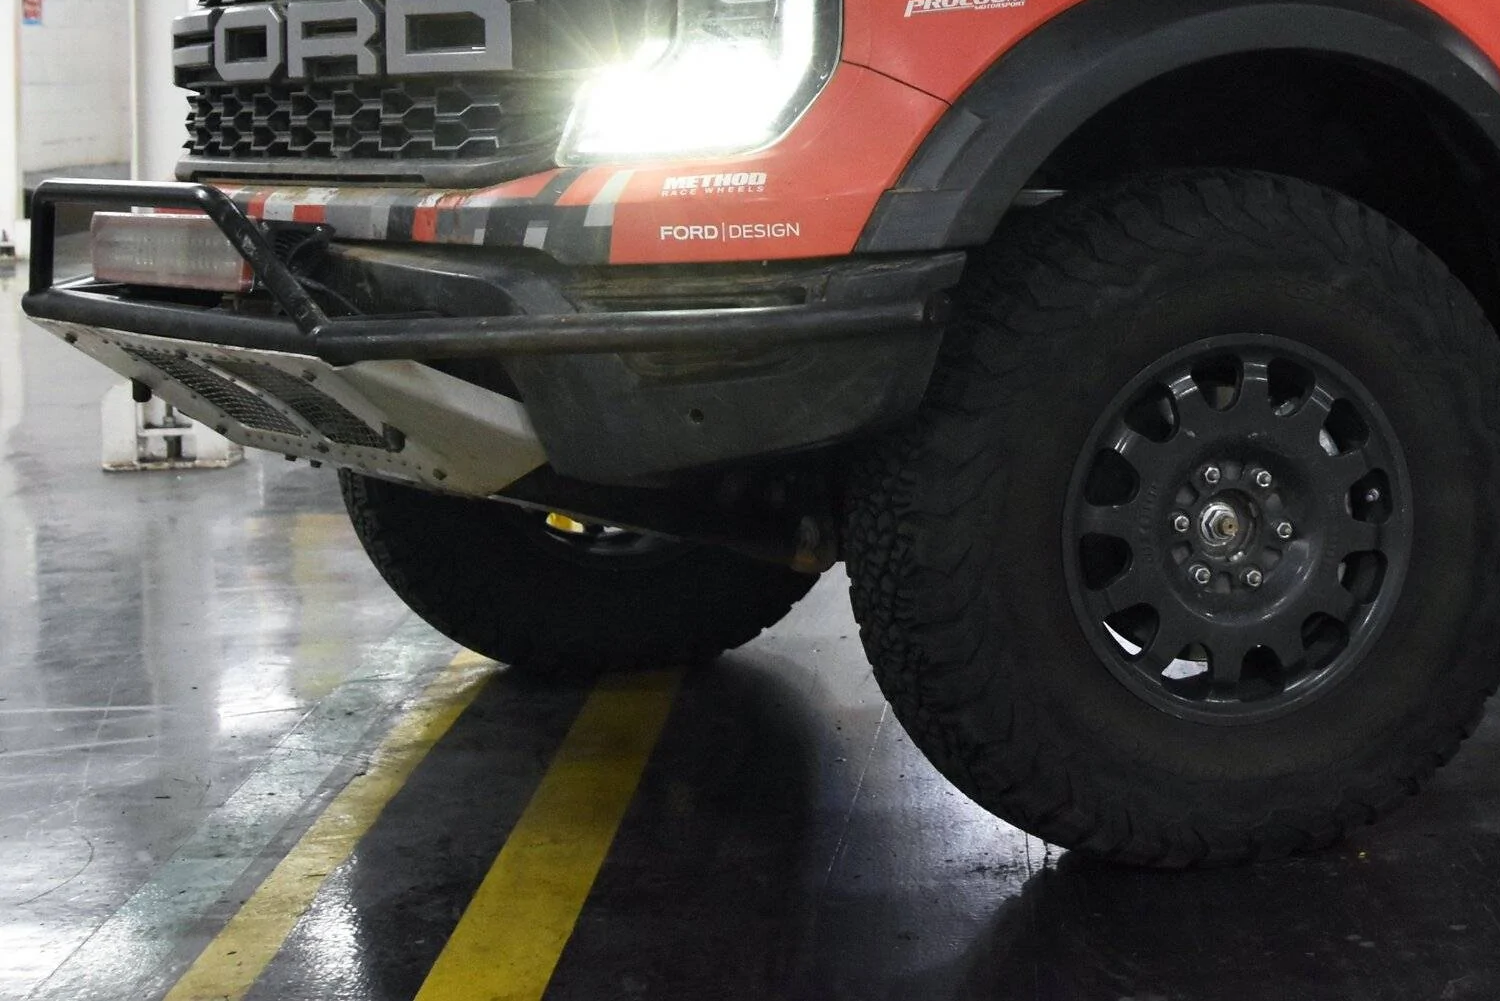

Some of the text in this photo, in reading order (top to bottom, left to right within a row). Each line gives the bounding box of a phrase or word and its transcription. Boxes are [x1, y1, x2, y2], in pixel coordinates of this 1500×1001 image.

[663, 172, 768, 190] METHOD
[661, 185, 766, 197] RACE WHEELS
[660, 222, 800, 241] FORD DESIGN
